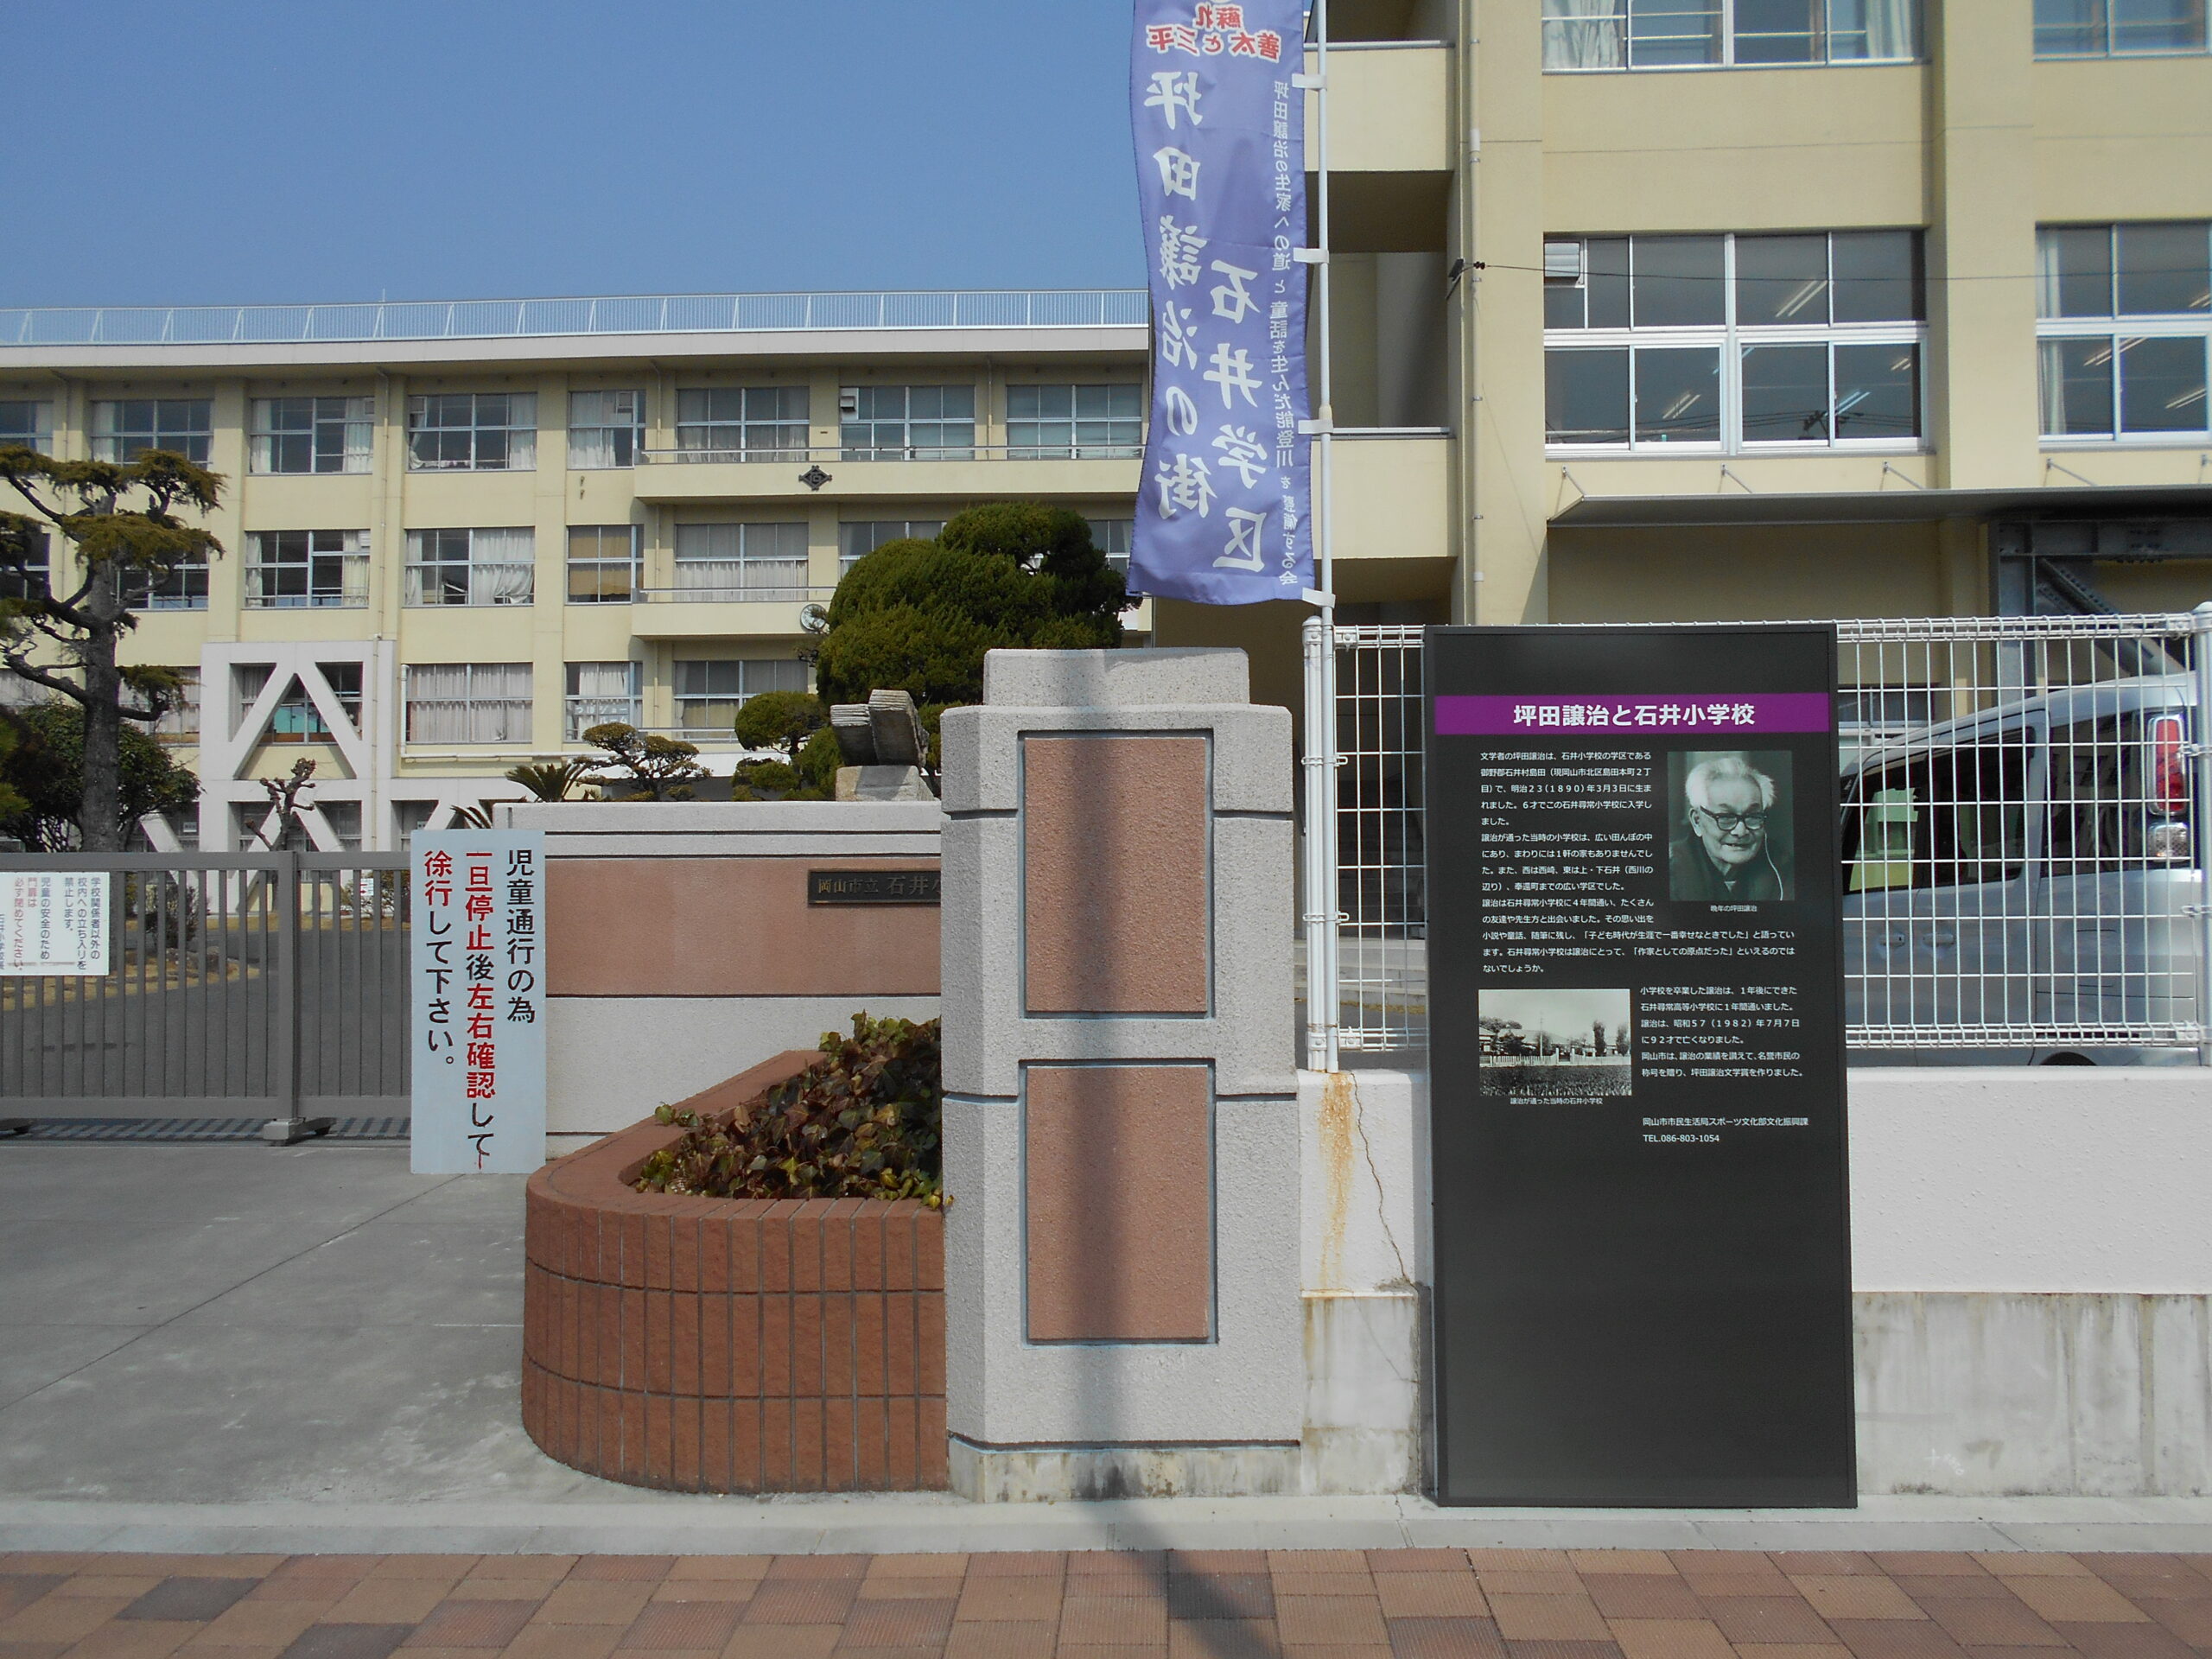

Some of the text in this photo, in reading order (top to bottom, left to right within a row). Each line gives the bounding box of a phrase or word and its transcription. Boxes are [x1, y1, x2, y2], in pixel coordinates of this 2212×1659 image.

[1513, 703, 1756, 727] 坪田譲治と石井小学校
[1479, 751, 1652, 761] 文学者の坪田譲治は、石井小学校の学区である
[1481, 817, 1510, 827] ました。
[1481, 832, 1653, 842] 譲治が通った当時の小学校は、広い田んぼの中
[817, 878, 879, 893] 岡山市立
[41, 877, 51, 960] 児童の安全のため
[77, 877, 87, 969] 校内への立ち入りを
[91, 877, 101, 959] 学校関係者以外の
[1482, 914, 1655, 925] の友達や先生方と出会いました。その思い出を
[505, 849, 536, 1024] 児童通行の為
[423, 849, 454, 1065] 徐行して下さい。
[1483, 963, 1545, 974] ないでしょうか。
[465, 851, 496, 1157] 一旦停止後左右確認して
[1643, 1134, 1720, 1143] TEL.086-803-1054
